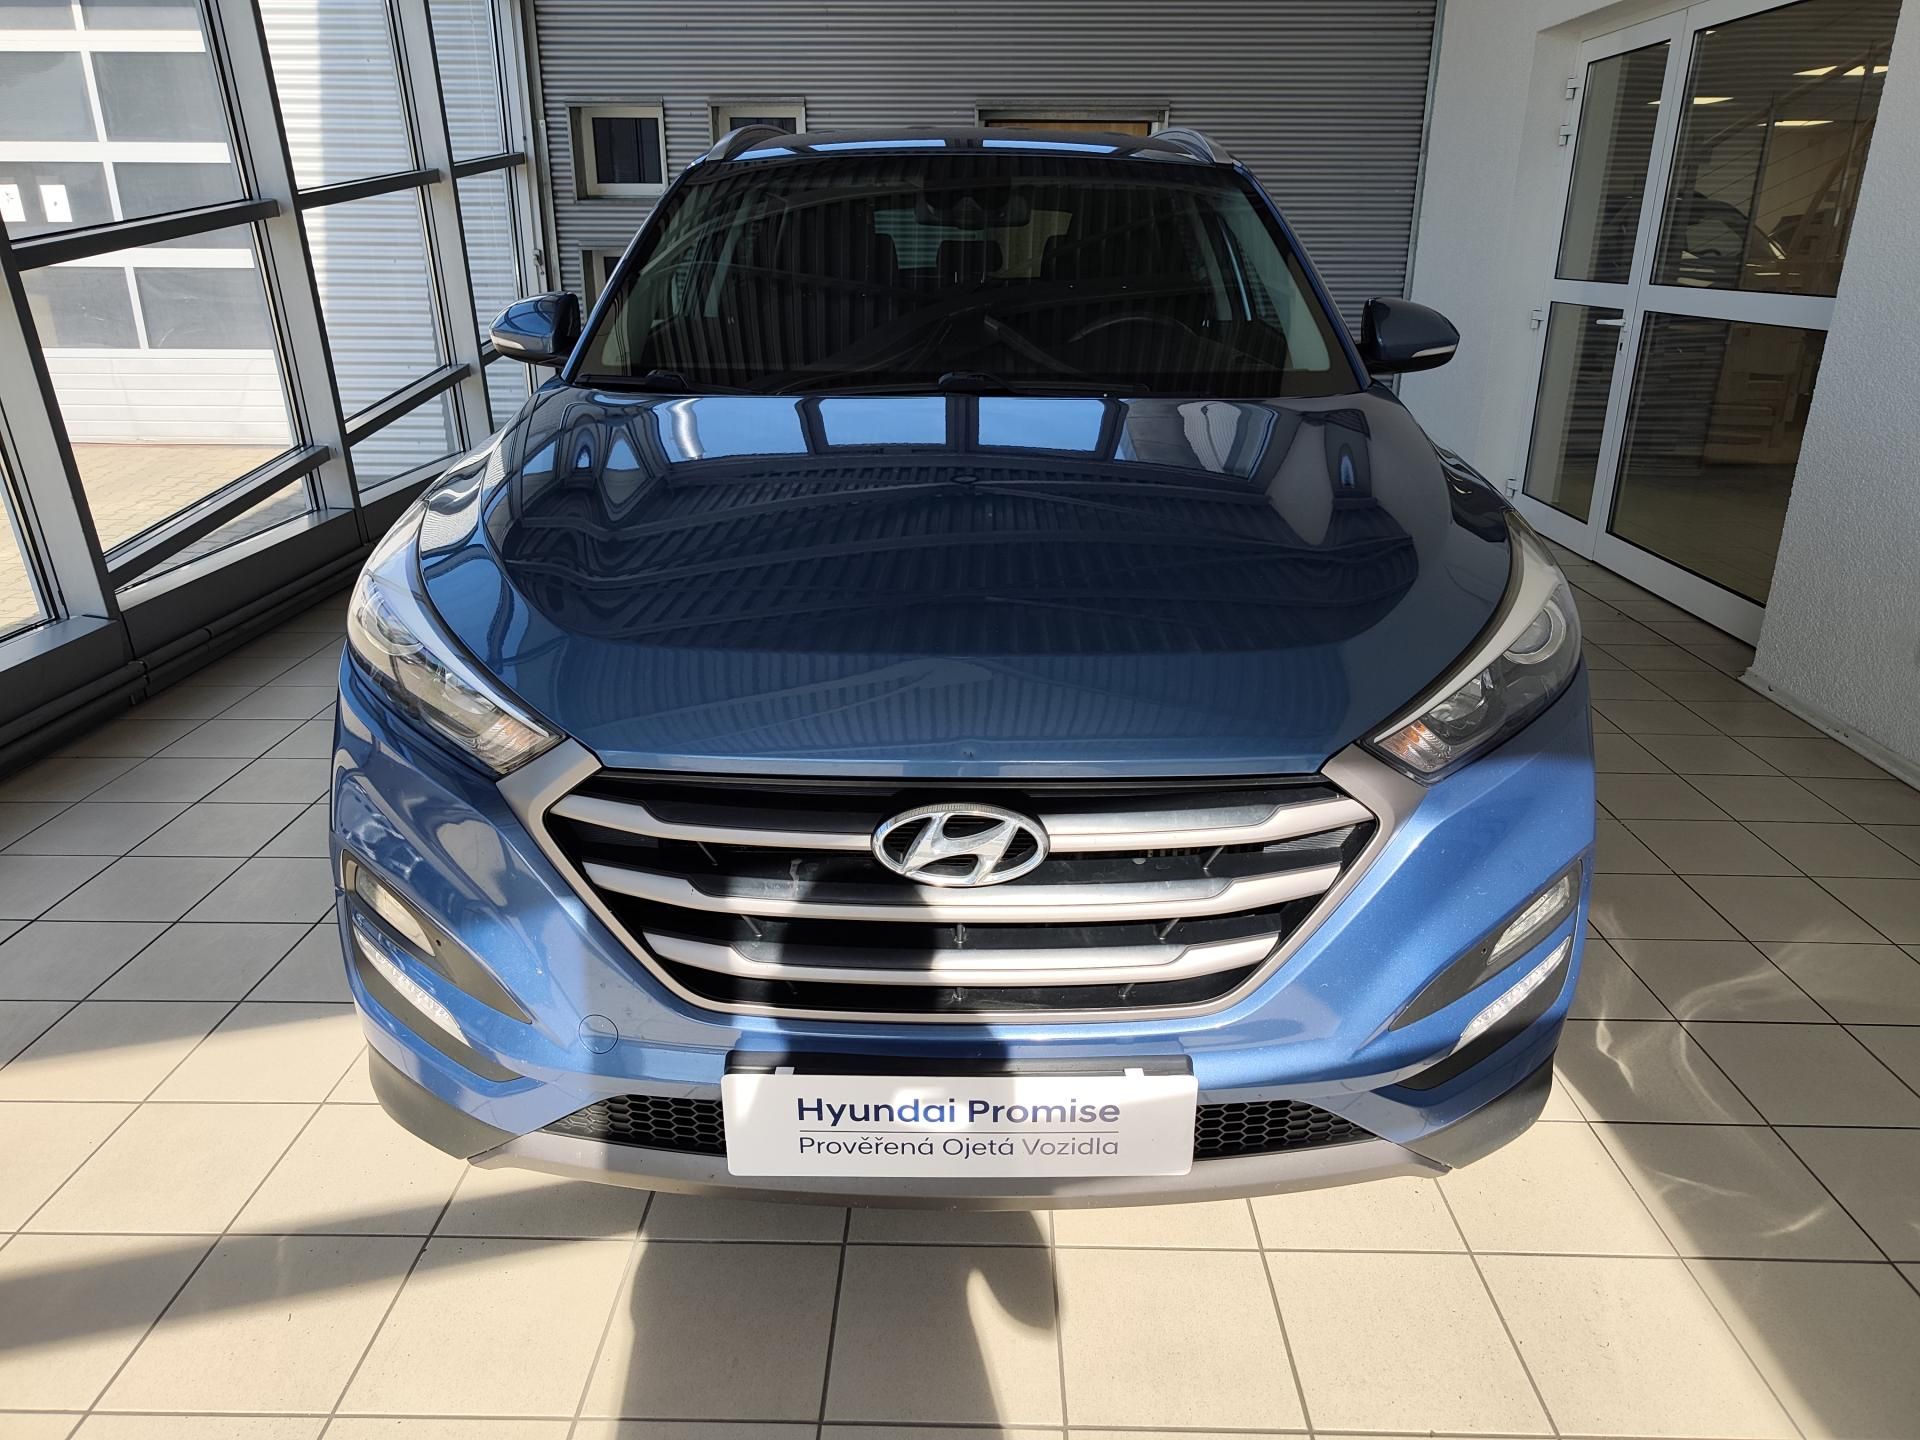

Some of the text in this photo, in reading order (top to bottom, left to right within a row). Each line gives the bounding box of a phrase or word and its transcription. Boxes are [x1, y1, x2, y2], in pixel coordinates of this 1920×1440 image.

[797, 1098, 1121, 1127] Hyundai Promise
[799, 1136, 1119, 1160] Prověřená Ojetá Vozidla
